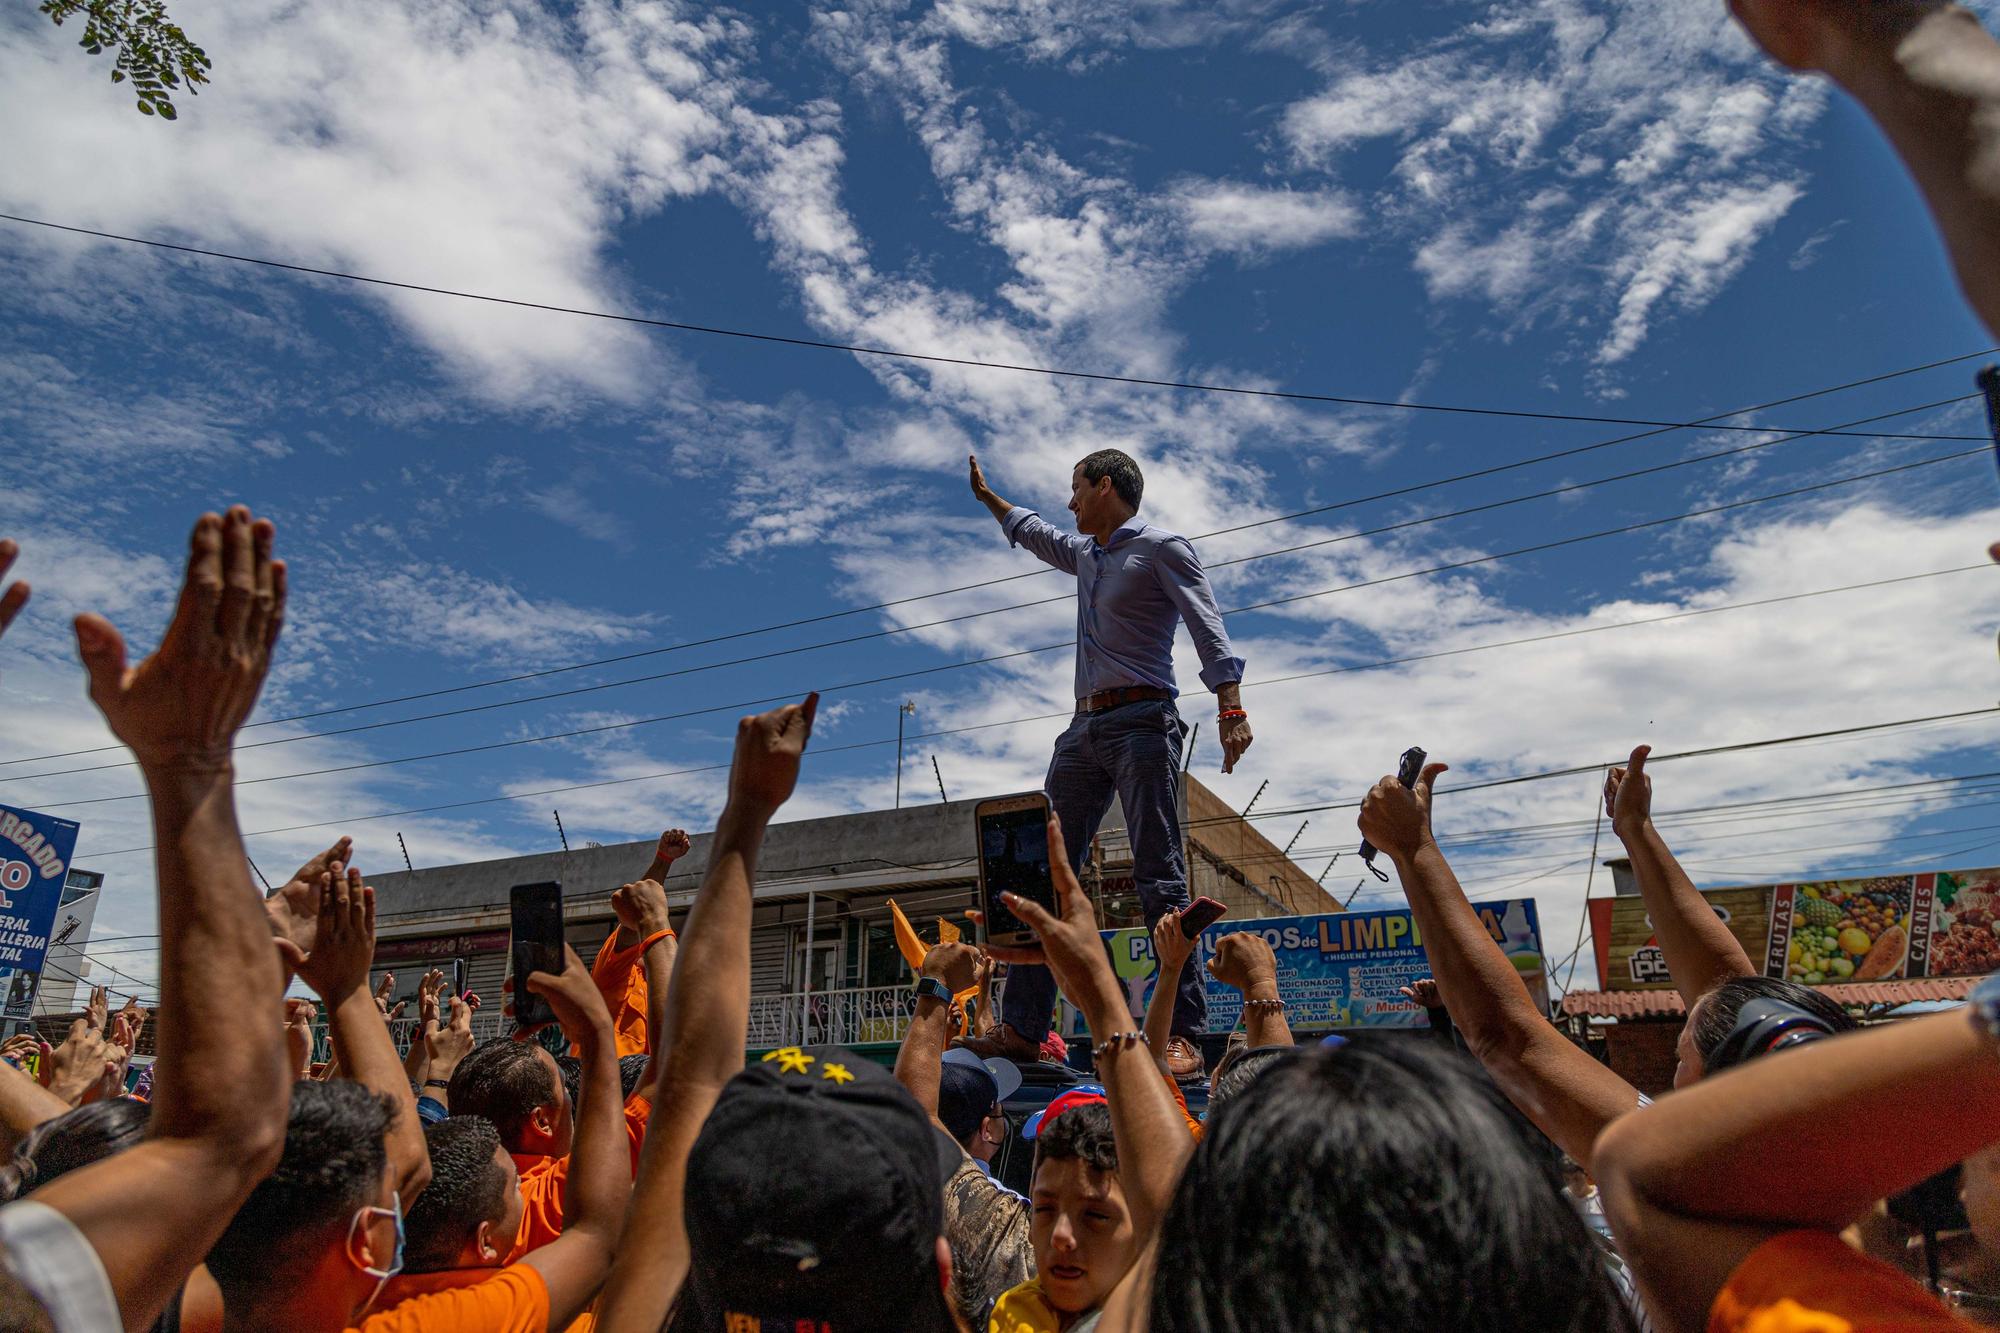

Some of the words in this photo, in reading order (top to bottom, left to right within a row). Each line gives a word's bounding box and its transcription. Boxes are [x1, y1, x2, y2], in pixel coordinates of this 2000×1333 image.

[1301, 936, 1319, 948] de
[1319, 908, 1504, 952] LIMPIA
[1911, 888, 1931, 961] CARNES
[1770, 900, 1790, 968] FRUTAS
[1330, 952, 1367, 960] HIGIENE
[1370, 949, 1418, 959] PERSONAL
[1363, 978, 1408, 987] CEPILLOS
[1309, 990, 1342, 998] PEINAR
[1366, 1005, 1372, 1015] y
